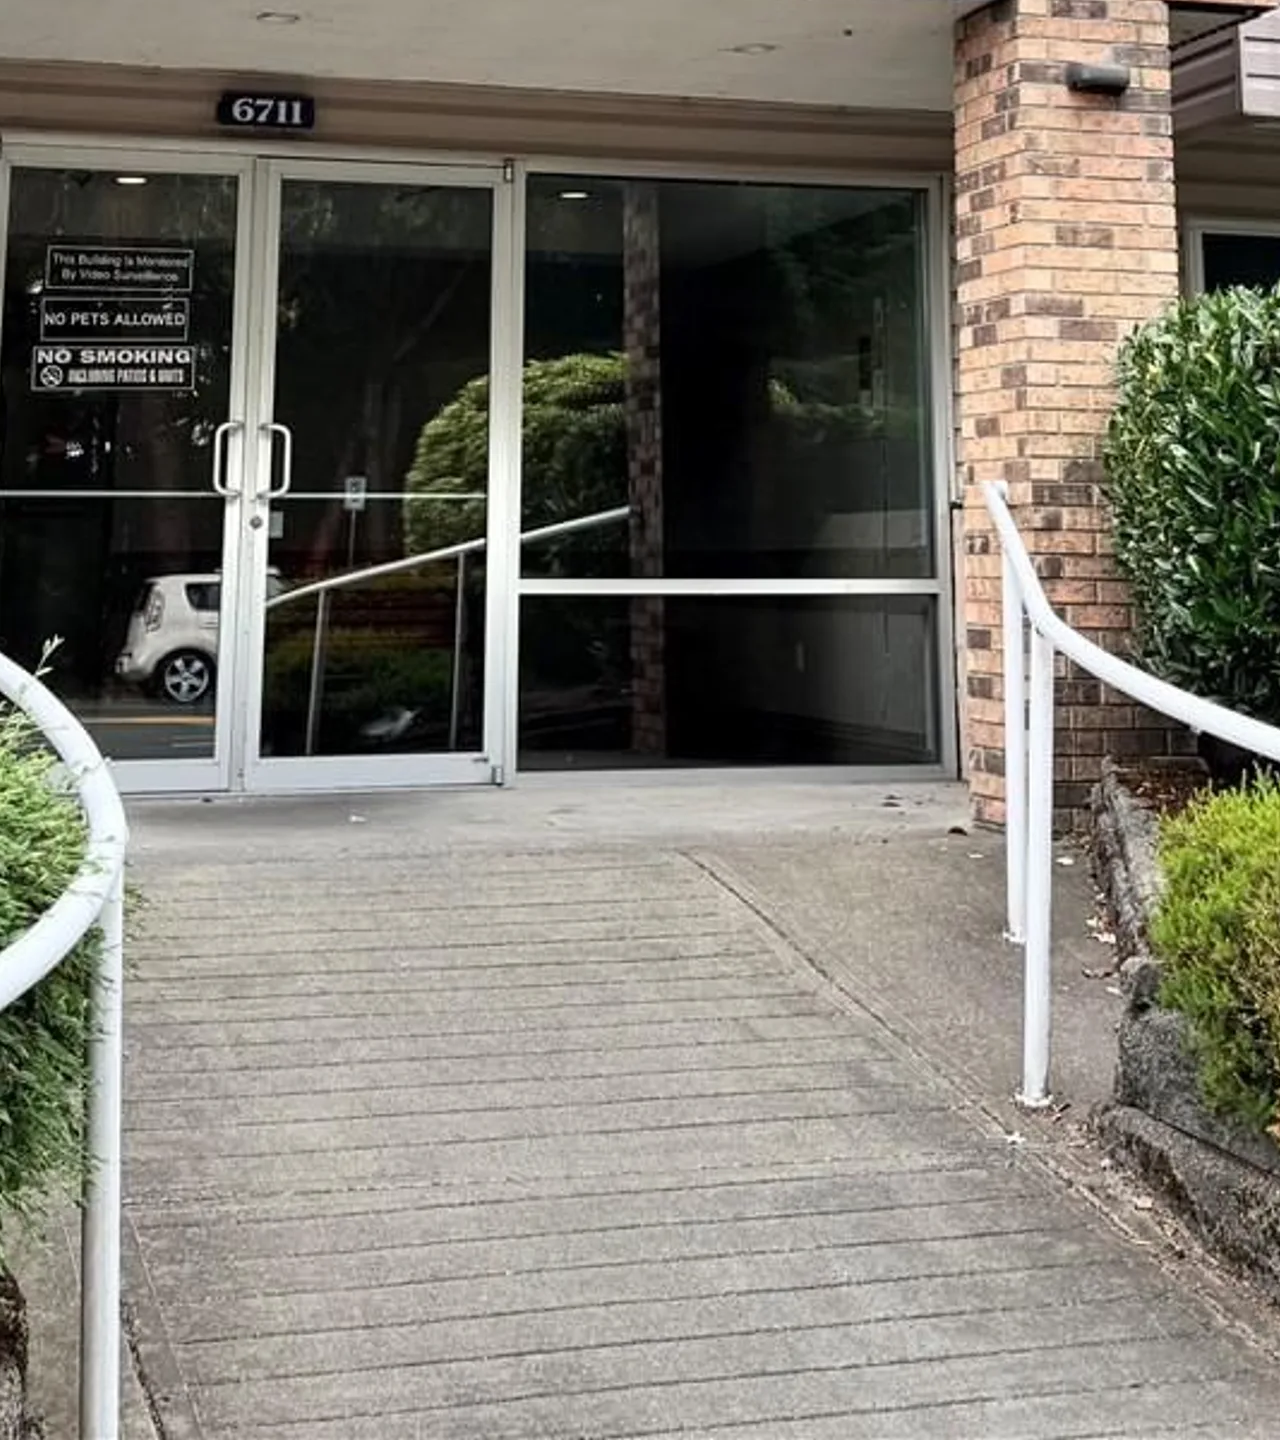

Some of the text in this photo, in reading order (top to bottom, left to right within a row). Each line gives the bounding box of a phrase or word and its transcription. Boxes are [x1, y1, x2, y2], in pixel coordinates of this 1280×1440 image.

[231, 97, 302, 124] 6711
[53, 252, 75, 265] This
[78, 254, 122, 268] Building
[61, 268, 77, 280] By
[79, 268, 111, 280] Video
[44, 312, 186, 327] NO PETS ALLOWED
[37, 349, 191, 364] NO SMOKING
